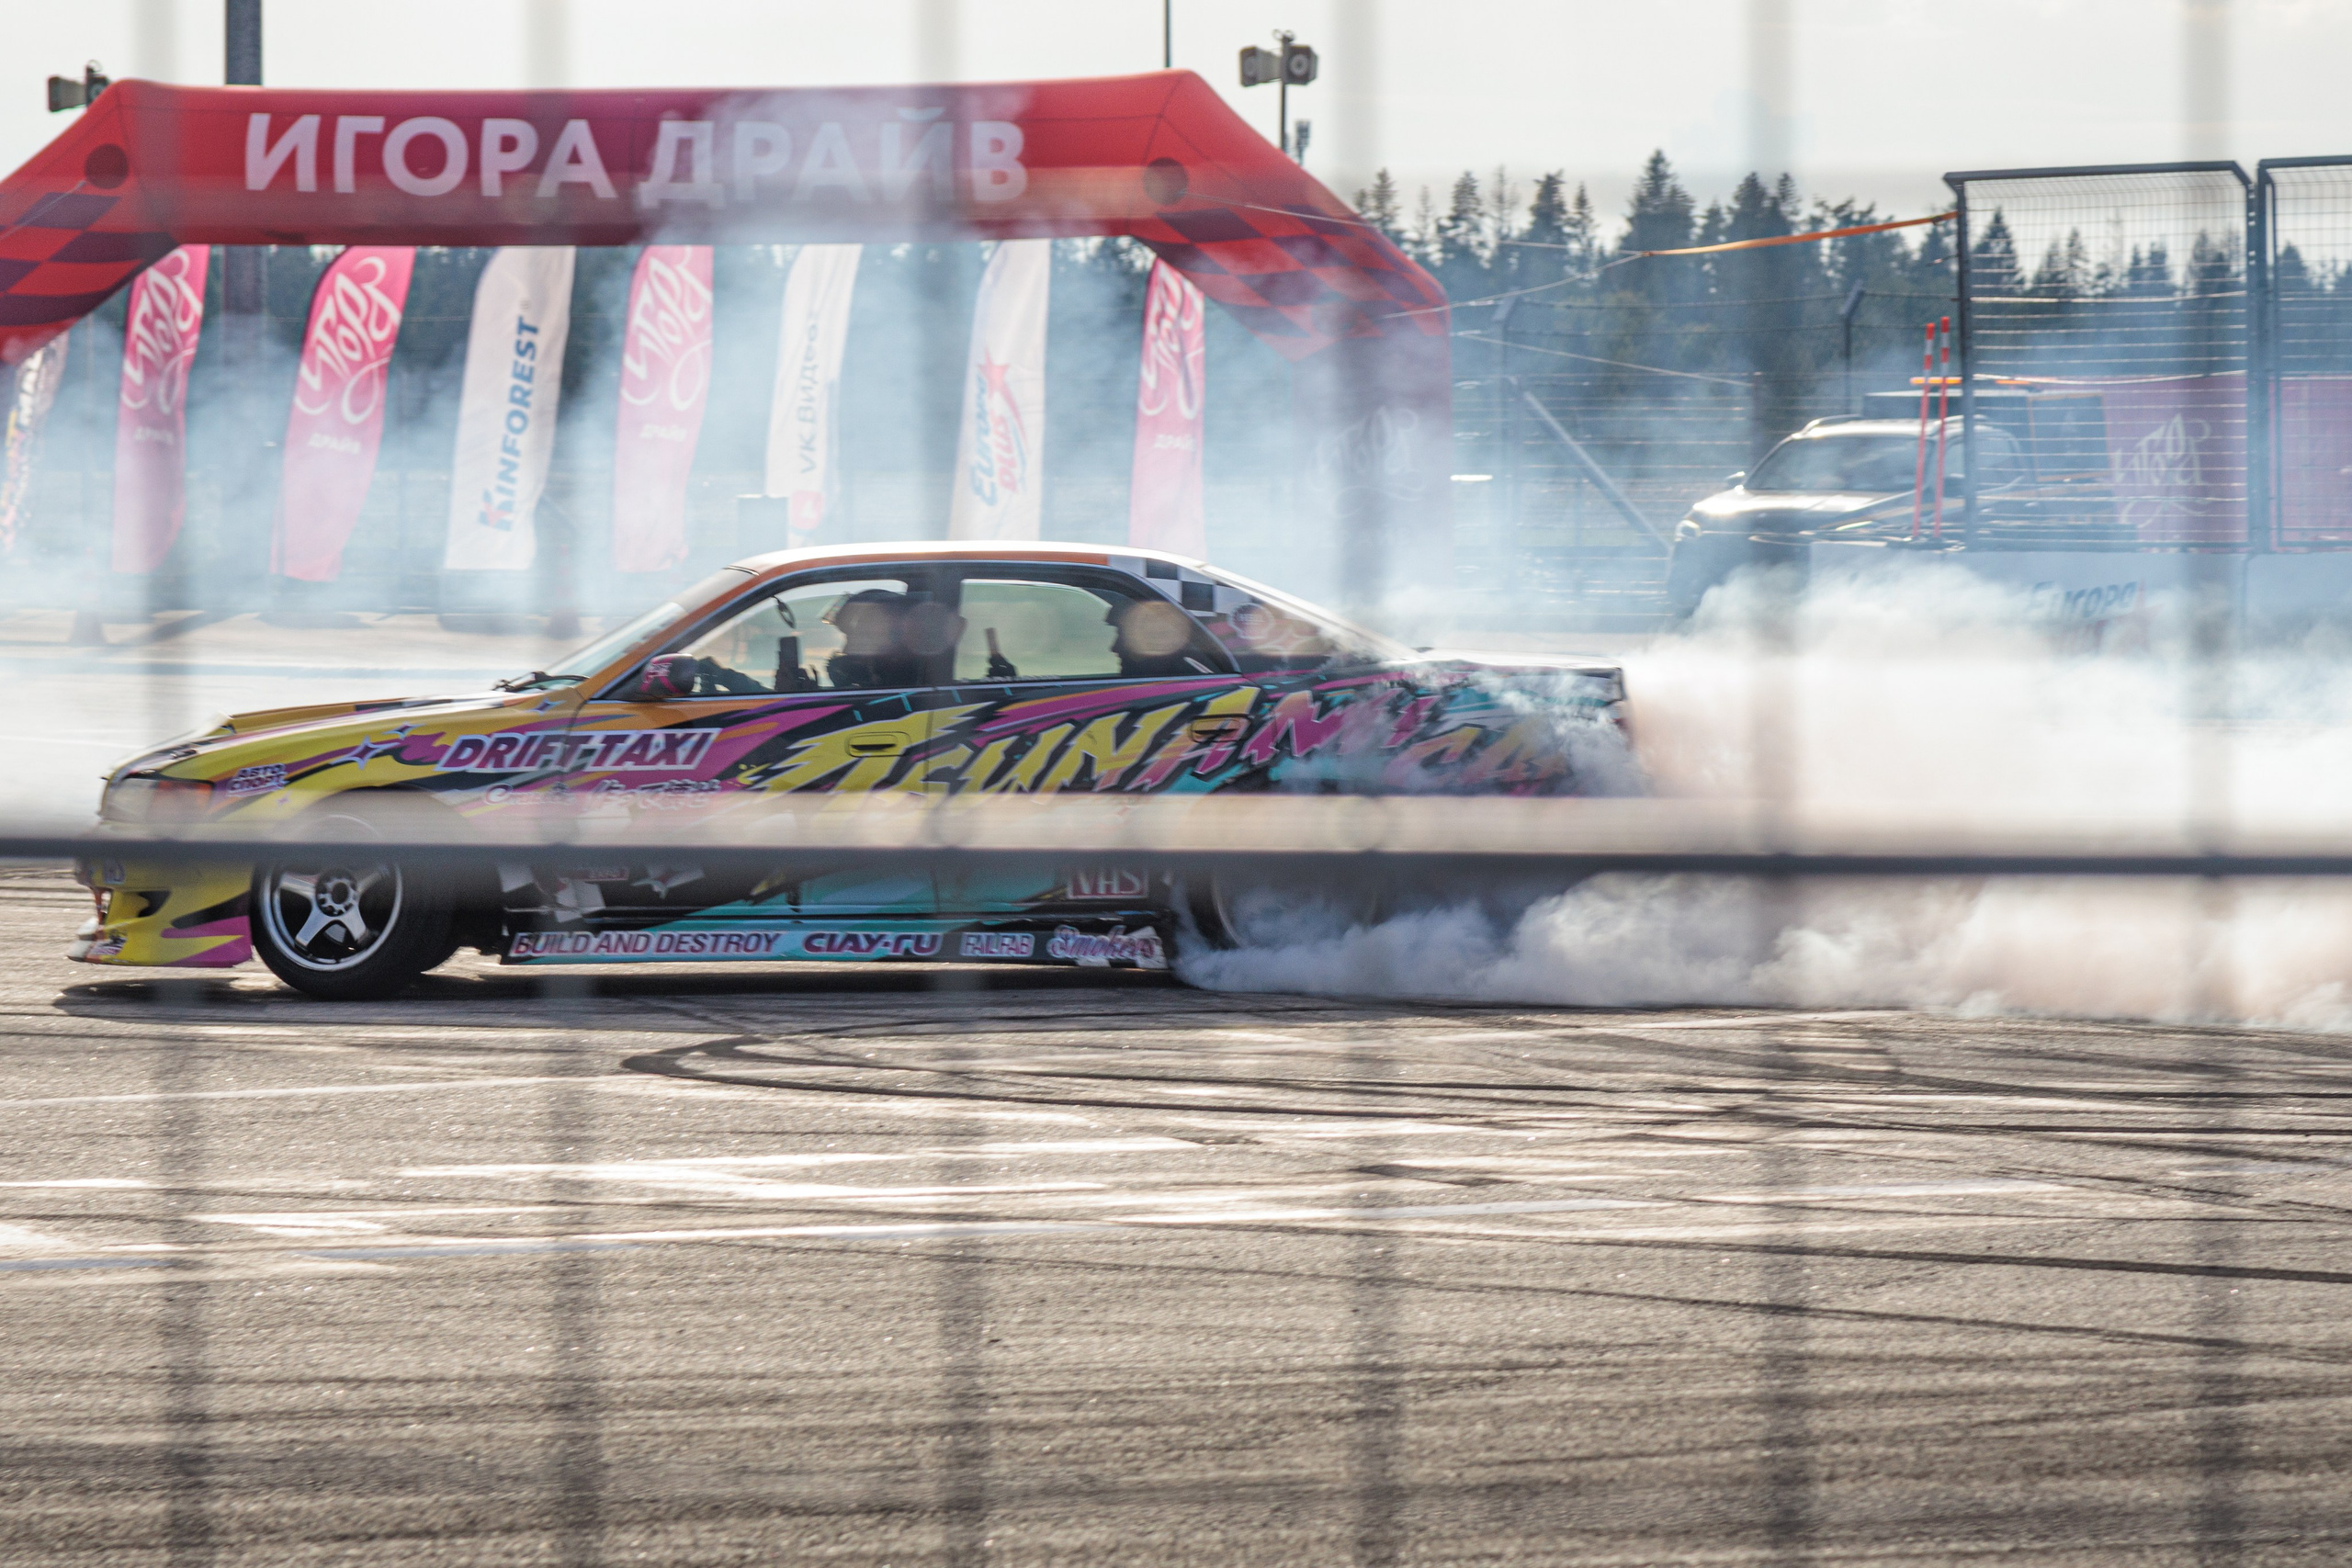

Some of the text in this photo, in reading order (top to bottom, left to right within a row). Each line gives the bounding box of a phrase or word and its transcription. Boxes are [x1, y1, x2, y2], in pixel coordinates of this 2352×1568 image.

[245, 106, 1029, 210] ИГОРА ДРАЙВ
[477, 315, 540, 533] KINFOREST
[437, 729, 720, 772] DRIFT TAXI
[510, 930, 786, 956] BUILD AND DESTROY
